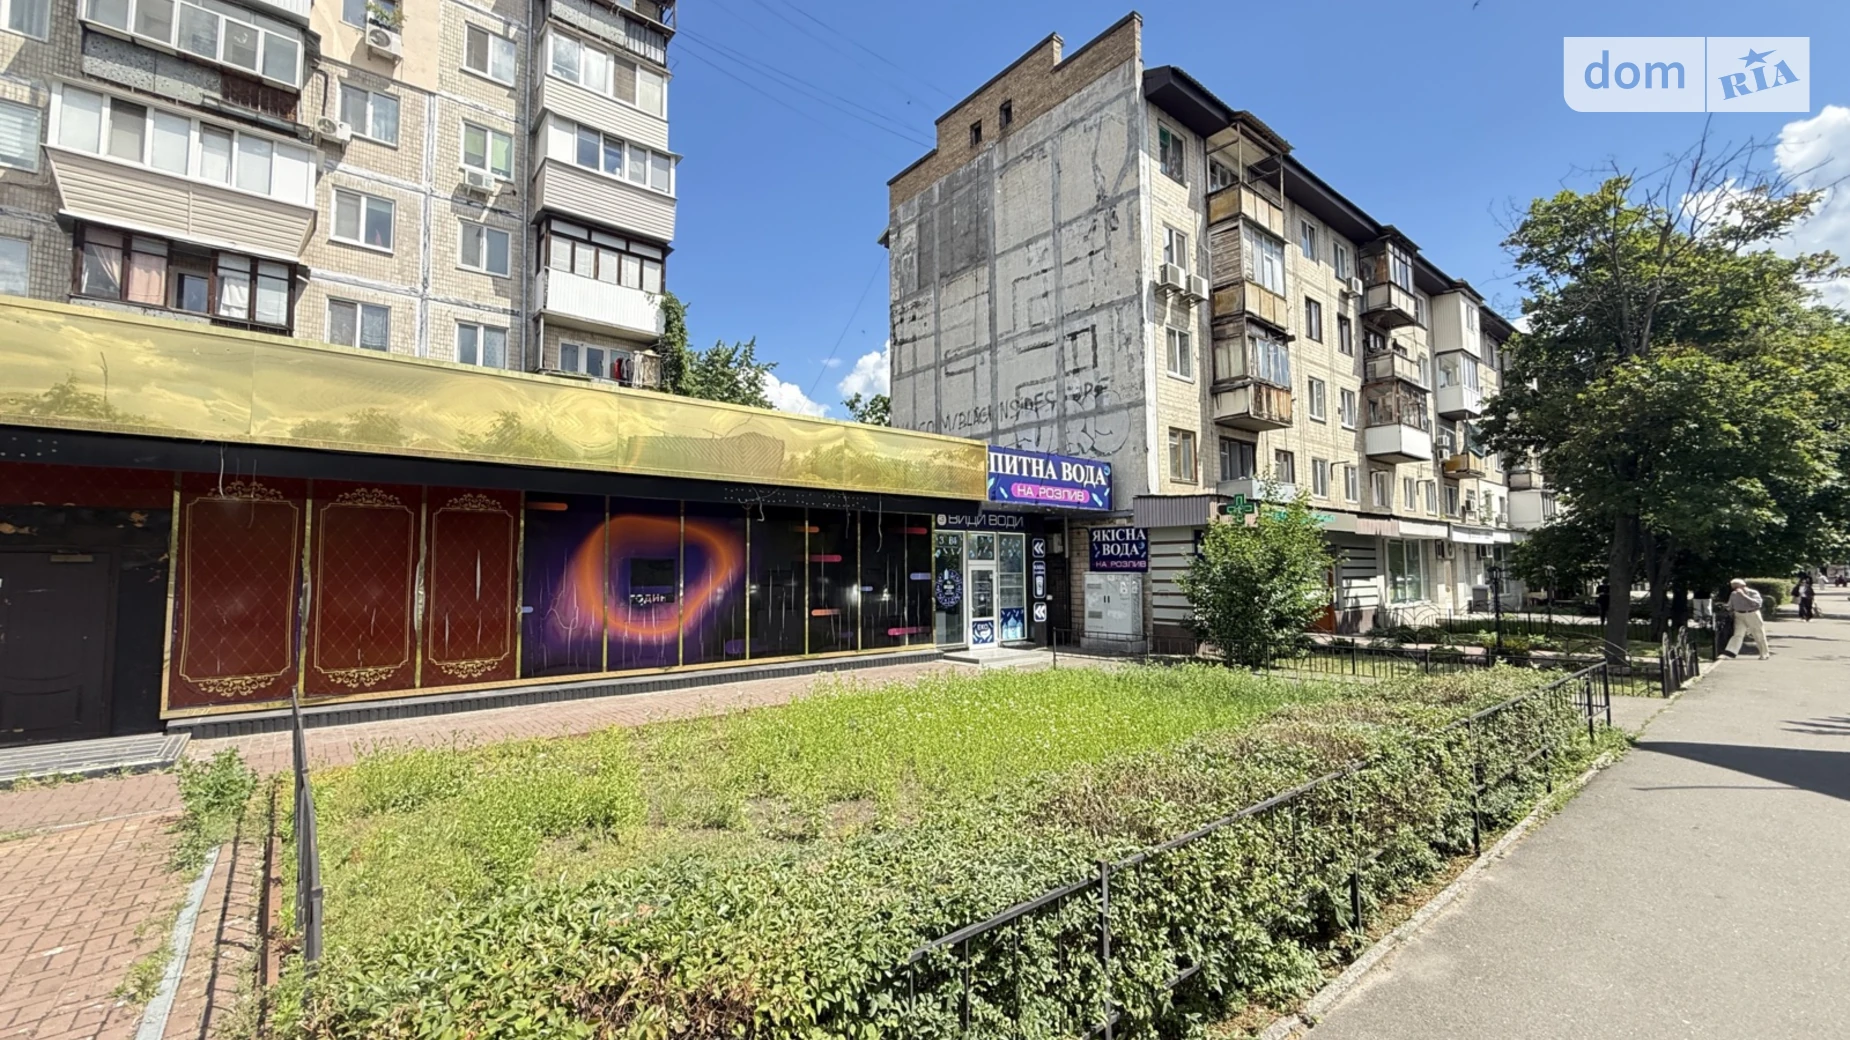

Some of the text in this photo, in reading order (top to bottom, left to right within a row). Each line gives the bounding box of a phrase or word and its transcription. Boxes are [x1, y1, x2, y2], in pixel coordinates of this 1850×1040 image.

[989, 451, 1107, 488] ПИТНА ВОДА
[1017, 485, 1085, 501] НА РОЗЛИВ
[988, 515, 1024, 529] ВОДИ
[1092, 528, 1146, 541] ЯКІСНА
[1102, 543, 1140, 558] ВОДА
[1095, 560, 1147, 568] НА РОЗЛИВ
